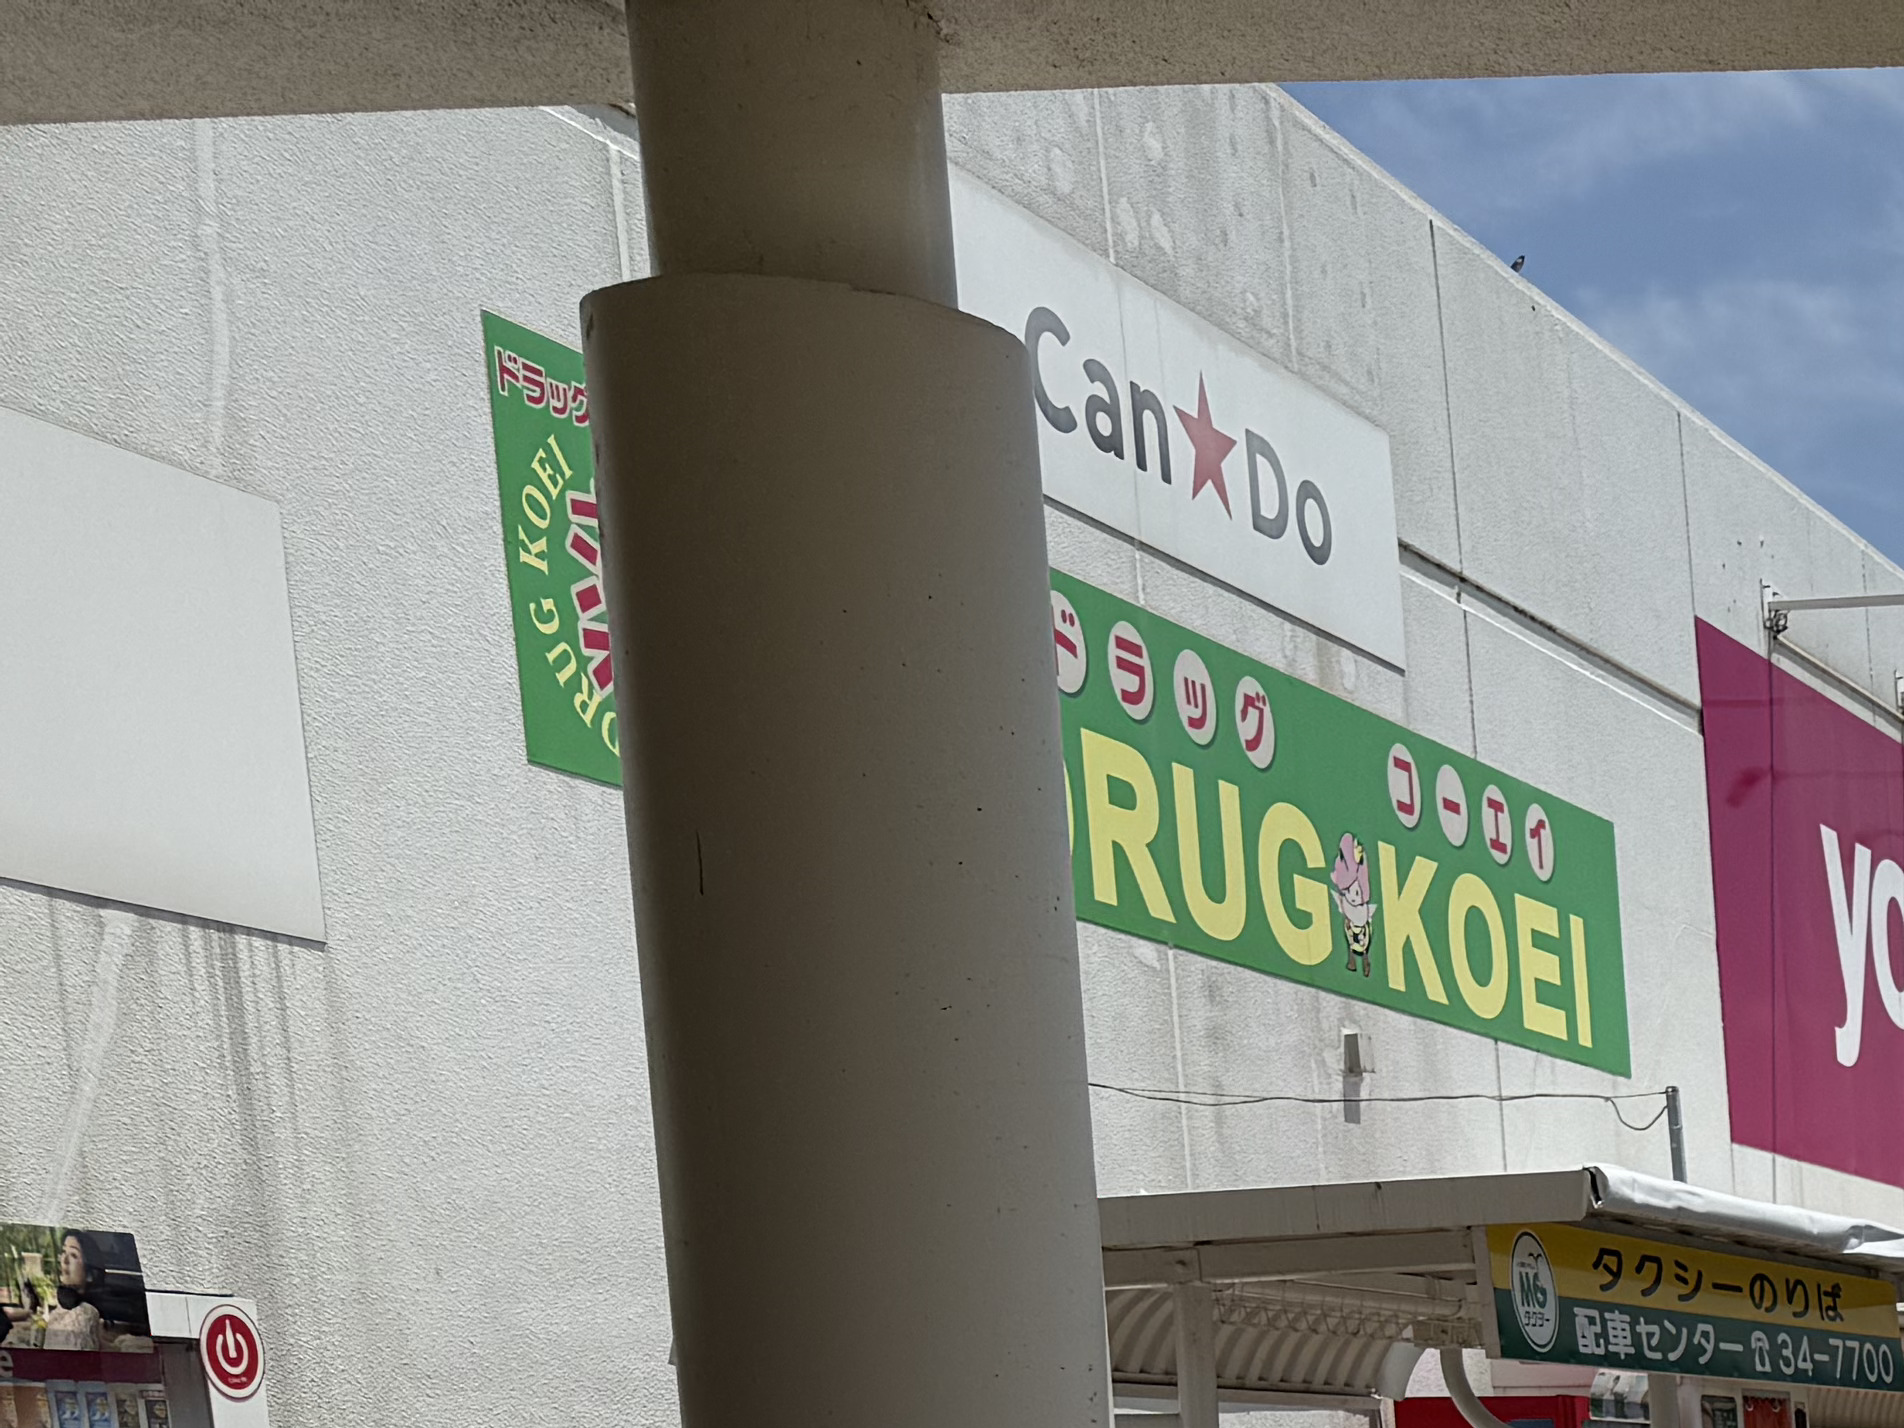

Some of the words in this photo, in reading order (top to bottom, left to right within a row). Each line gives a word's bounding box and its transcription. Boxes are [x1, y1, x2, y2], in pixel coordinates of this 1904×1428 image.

[1025, 306, 1172, 486] Can
[1245, 427, 1332, 566] Do
[519, 434, 574, 576] KOEI
[1392, 754, 1546, 871] コーエイ
[1065, 726, 1333, 967] RUG
[1377, 840, 1593, 1049] KOEI
[1573, 1306, 1744, 1366] 配車センター
[1591, 1247, 1844, 1323] タクシーのりば
